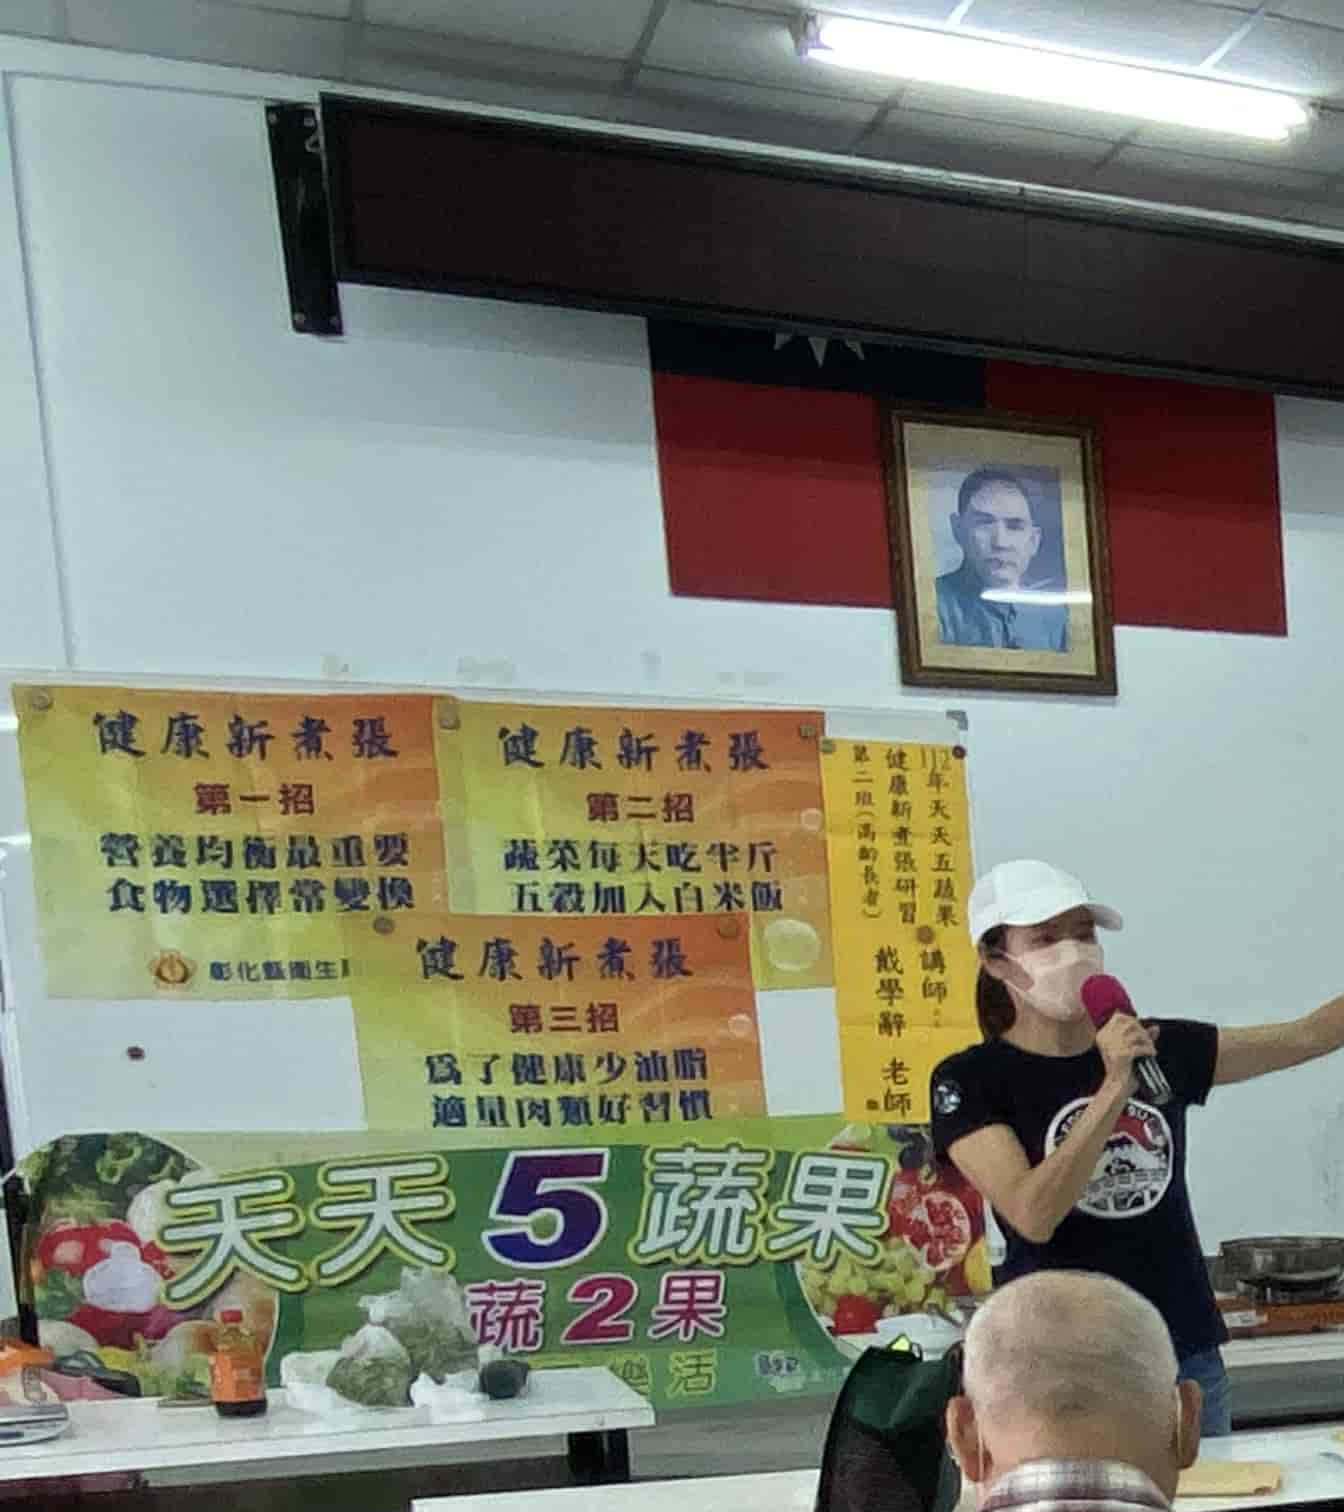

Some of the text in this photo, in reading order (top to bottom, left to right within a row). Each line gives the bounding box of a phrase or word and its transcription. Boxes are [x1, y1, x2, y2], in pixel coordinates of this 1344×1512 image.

[93, 710, 398, 761] 健康新煮張
[498, 723, 770, 772] 健康新煮張
[194, 783, 315, 815] 第一招
[586, 792, 694, 823] 第二招
[100, 832, 409, 869] 營養均衡最重要
[504, 839, 776, 873] 蔬菜每天吃半斤
[106, 877, 415, 915] 食物選擇常變換
[512, 880, 783, 914] 五穀加入白米飯
[209, 958, 350, 982] 彰化縣衛生
[416, 934, 694, 981] 健康新煮張
[509, 1002, 620, 1033] 第三招
[432, 1089, 713, 1128] 適量肉類好習慣
[160, 1142, 888, 1307] 天天5蔬果
